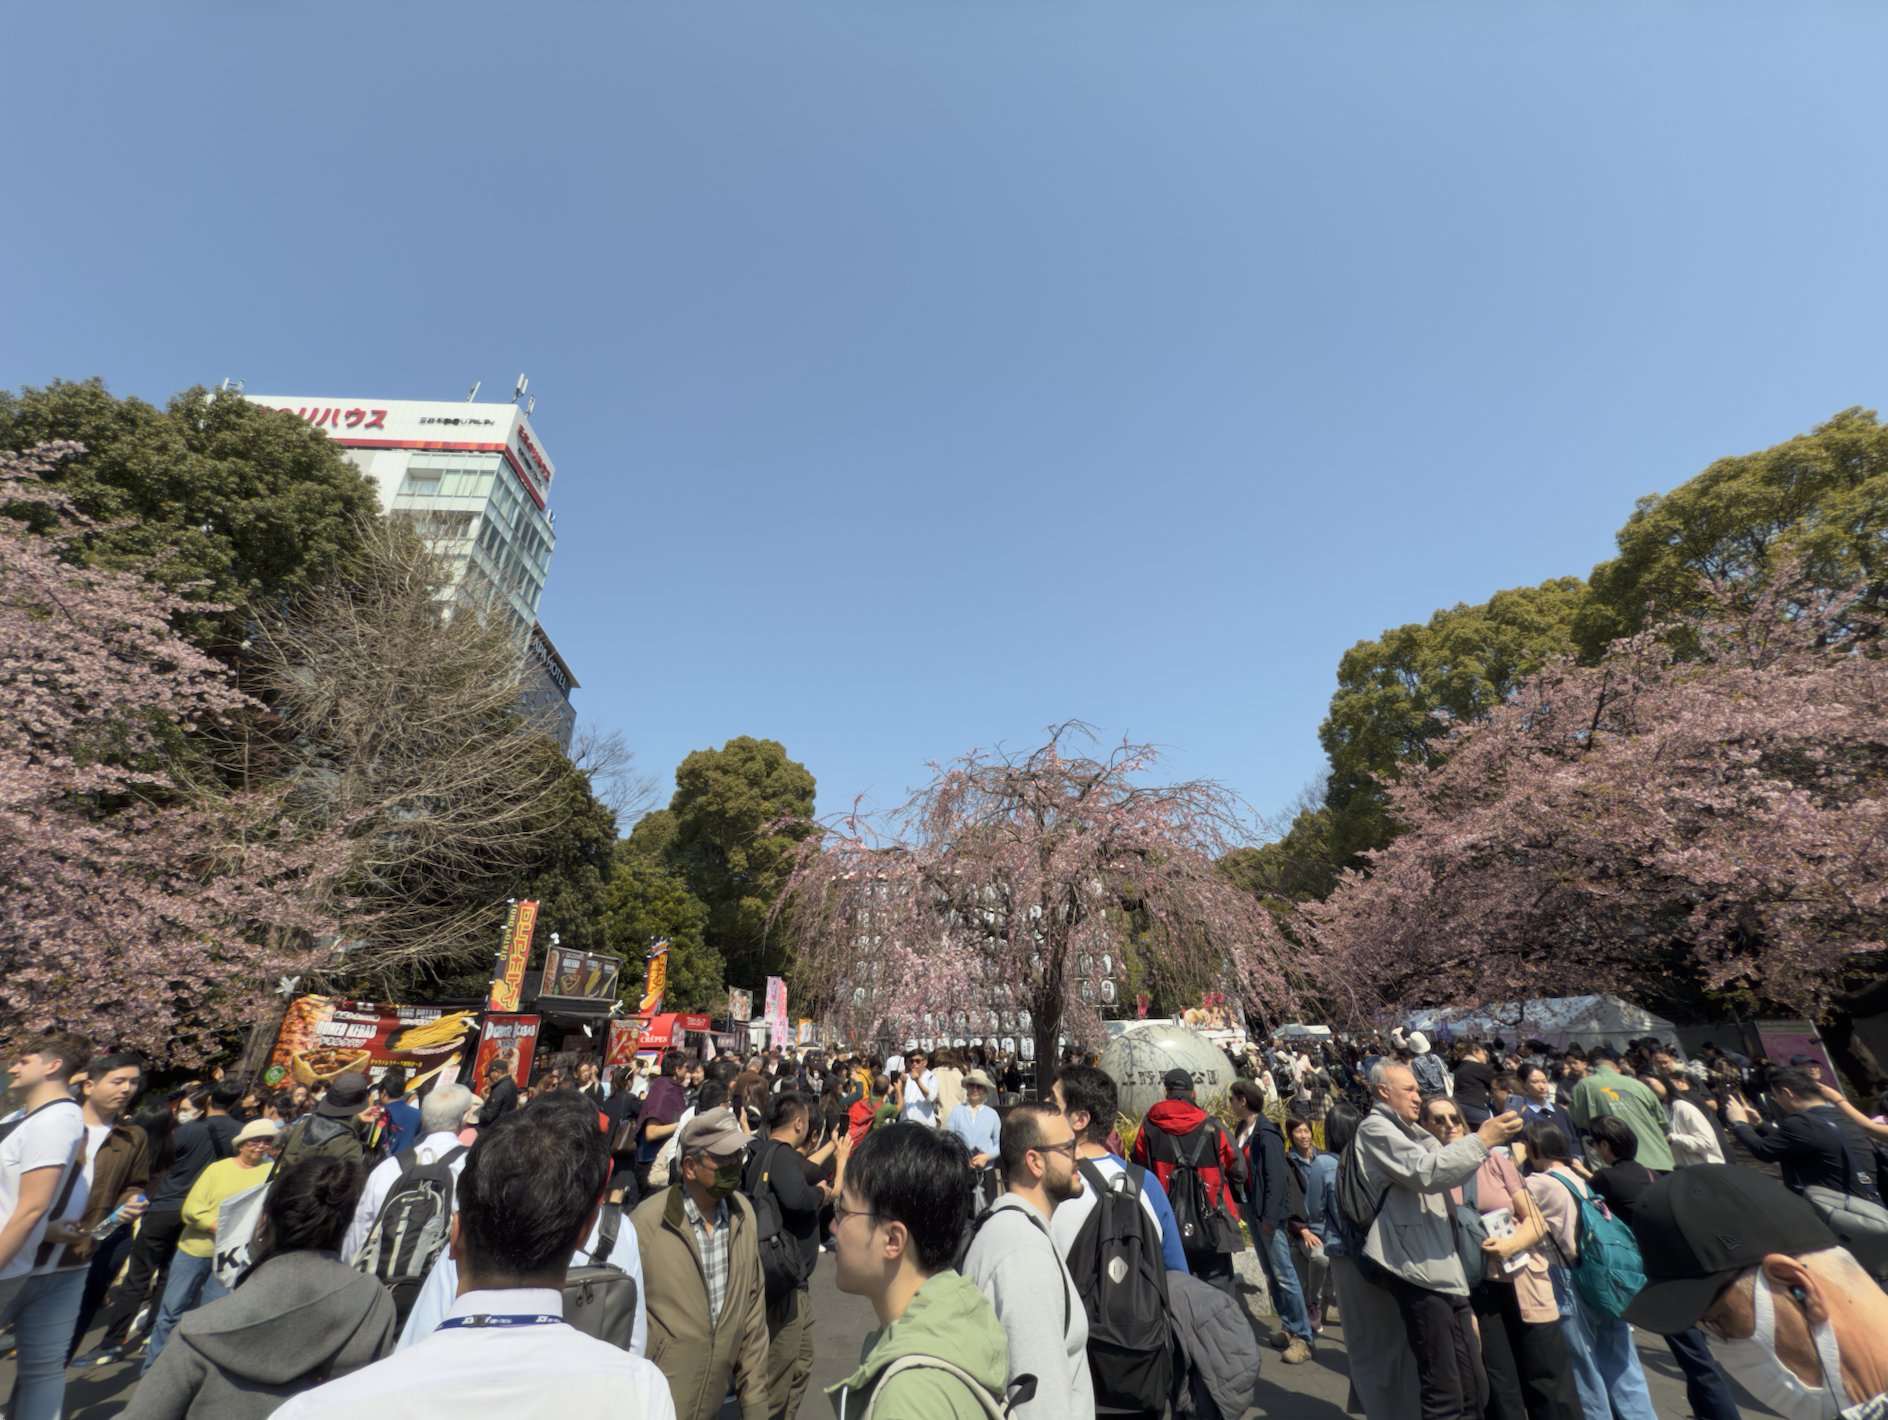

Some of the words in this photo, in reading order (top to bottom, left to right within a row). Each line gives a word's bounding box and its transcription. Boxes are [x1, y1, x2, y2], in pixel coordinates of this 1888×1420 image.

[640, 1035, 668, 1044] CRÊPES
[1122, 1069, 1218, 1086] 上野公園
